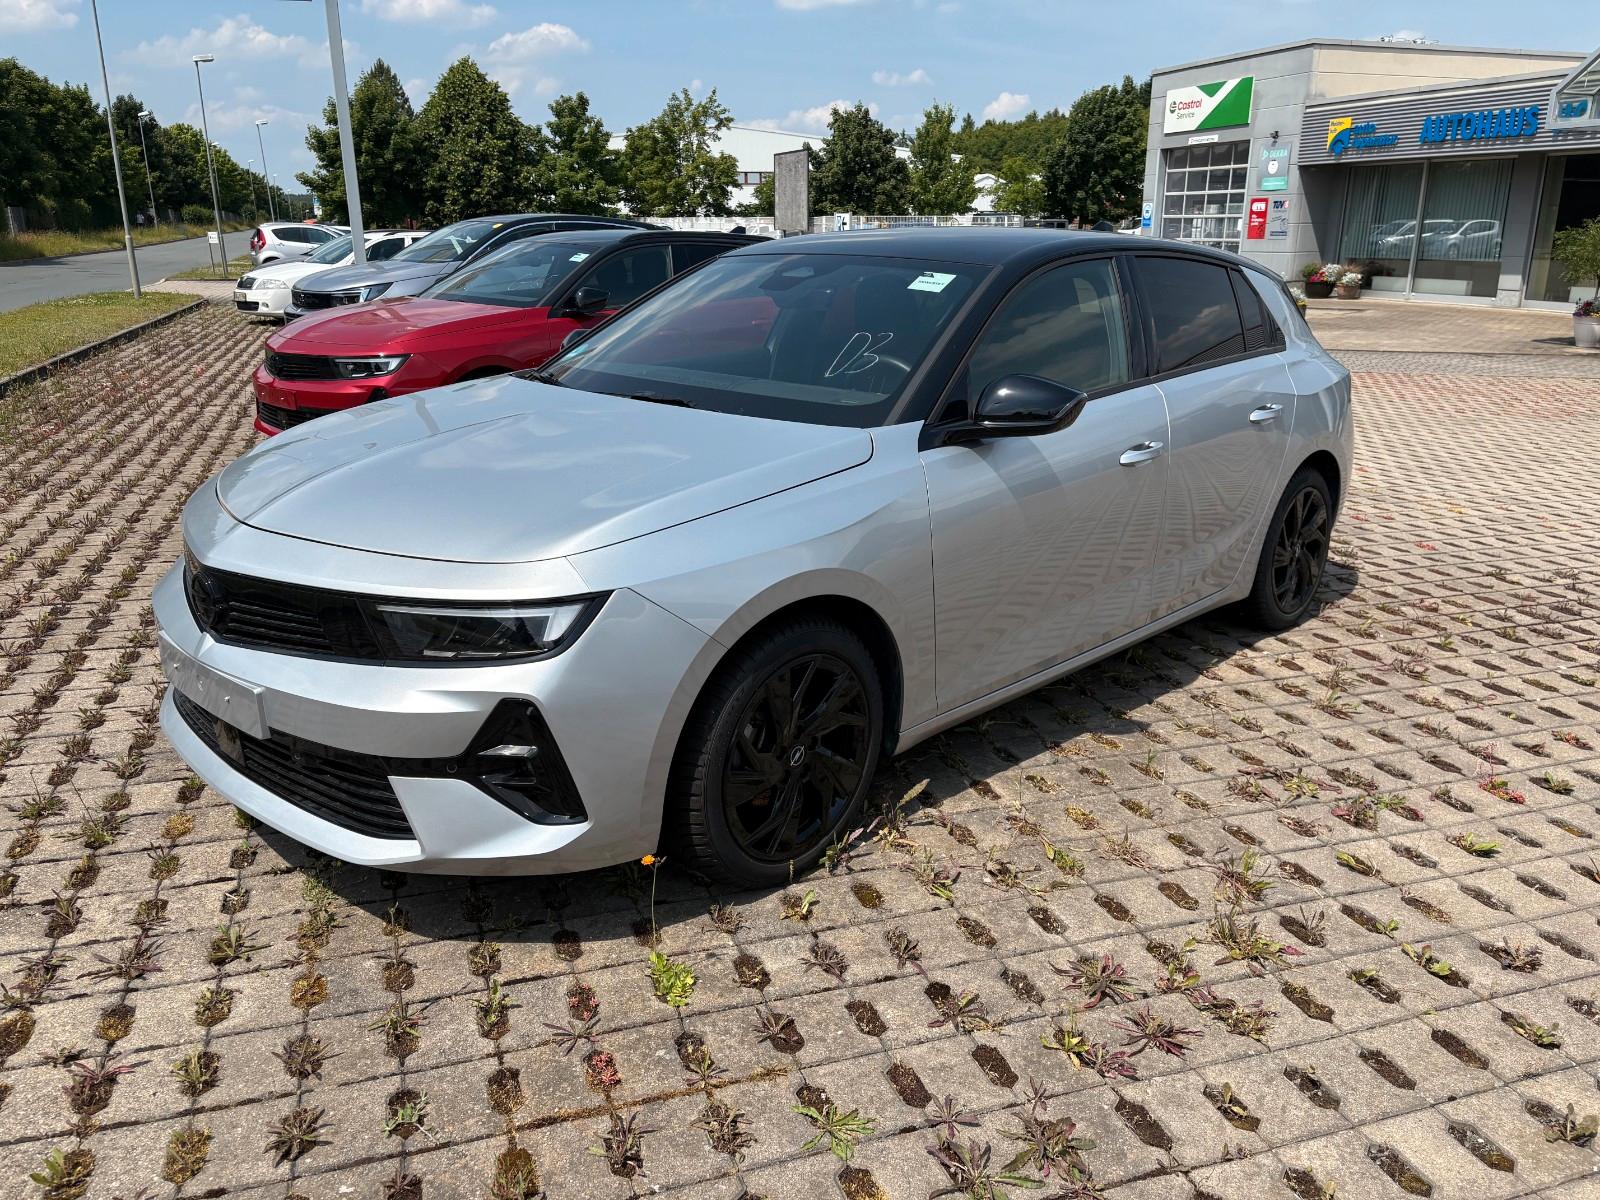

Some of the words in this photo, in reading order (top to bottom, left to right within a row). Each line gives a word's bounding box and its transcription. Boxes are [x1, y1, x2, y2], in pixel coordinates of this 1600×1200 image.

[1178, 98, 1203, 111] Castrol
[1176, 111, 1195, 120] Service
[1420, 105, 1539, 143] AUTOHAUS
